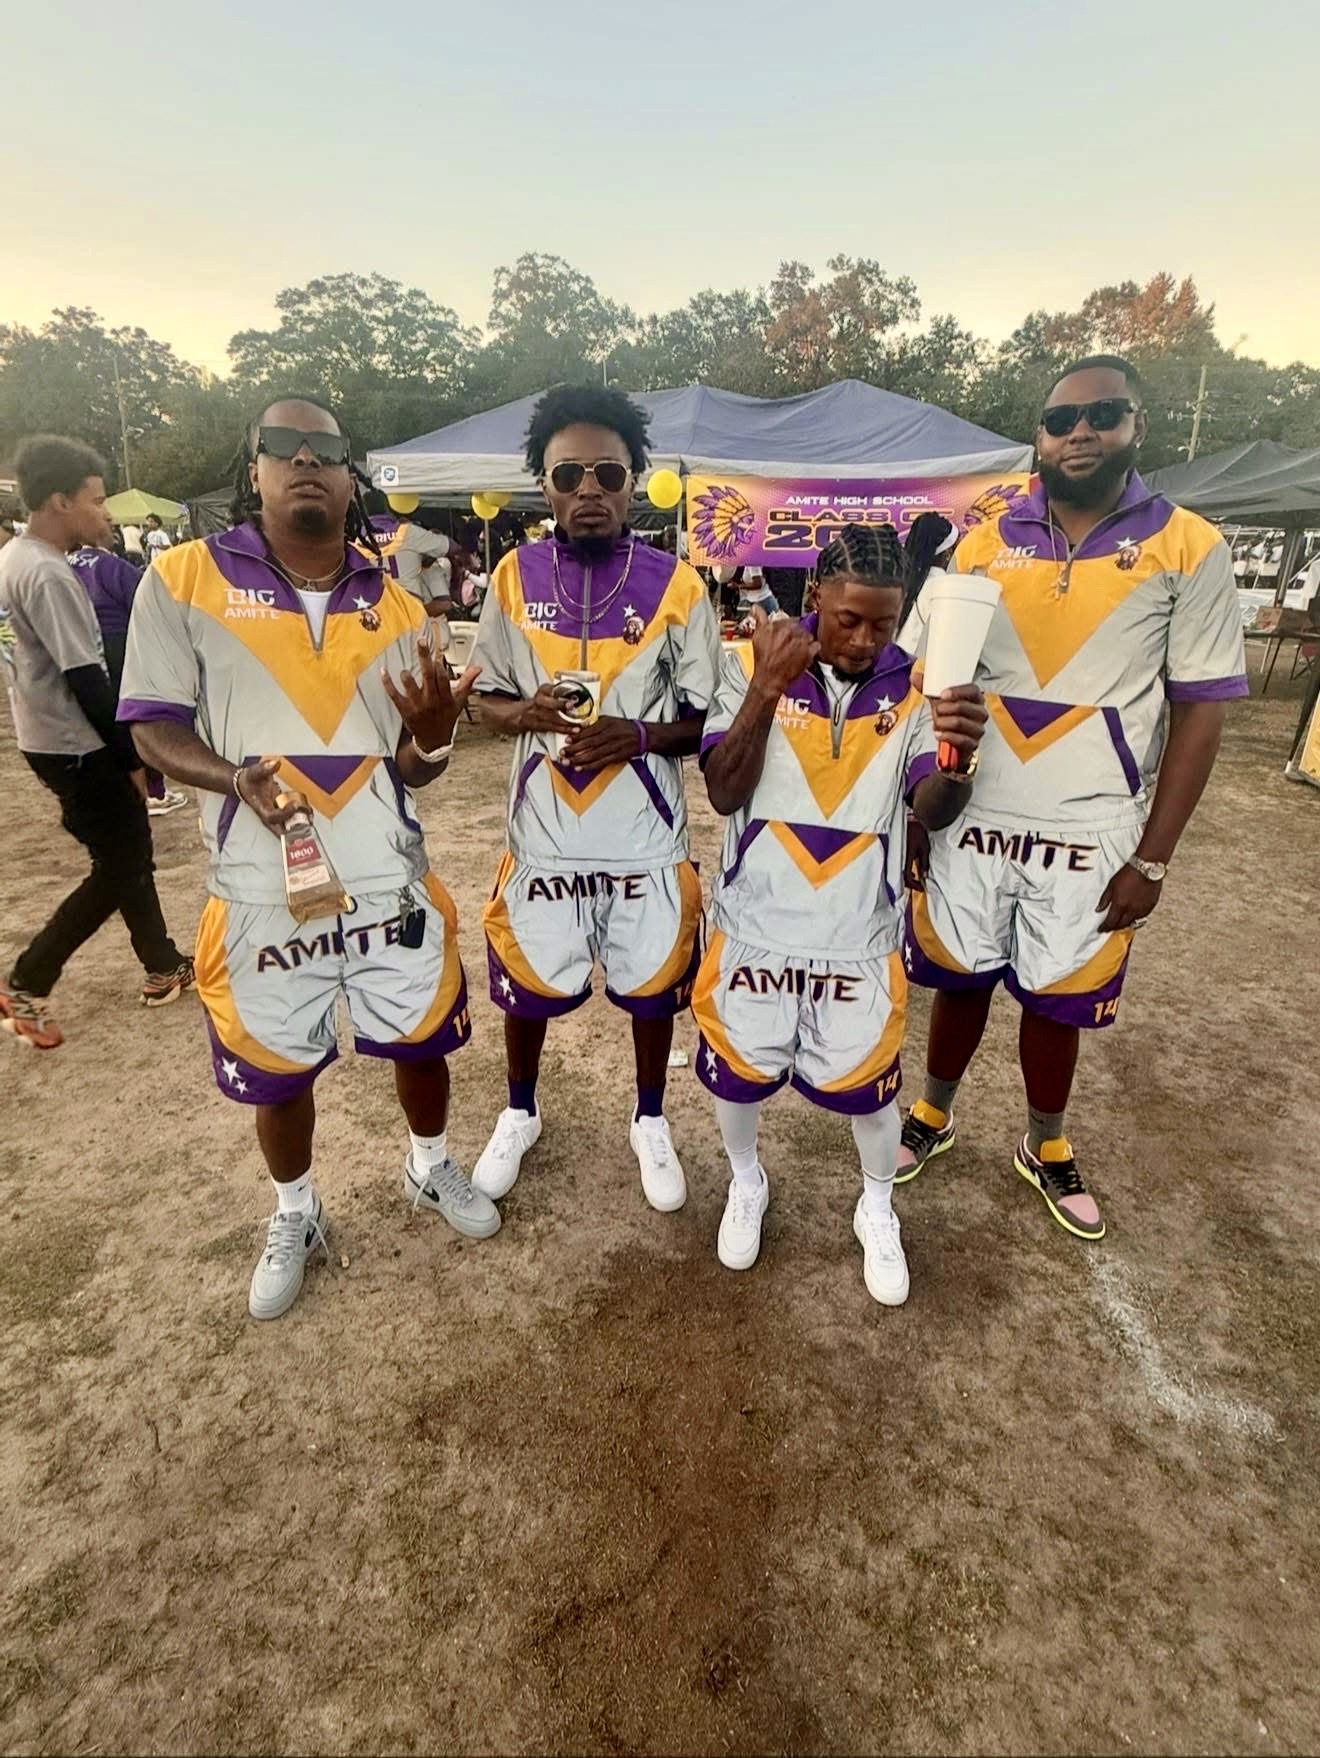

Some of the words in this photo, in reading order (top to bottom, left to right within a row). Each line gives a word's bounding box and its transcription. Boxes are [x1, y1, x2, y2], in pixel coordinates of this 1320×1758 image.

[786, 496, 829, 505] AMITE
[834, 496, 867, 505] HIGH
[873, 496, 934, 505] SCHOOL
[768, 509, 890, 523] CLASS
[224, 588, 276, 606] BIG
[224, 607, 281, 619] AMITE
[524, 602, 558, 619] BIG
[775, 714, 810, 730] MITE
[958, 827, 1099, 872] AMITE
[527, 871, 650, 901] AMITE
[257, 914, 401, 973] AMITE
[728, 965, 866, 1003] AMITE
[1094, 997, 1119, 1024] 14
[876, 1069, 899, 1102] 14
